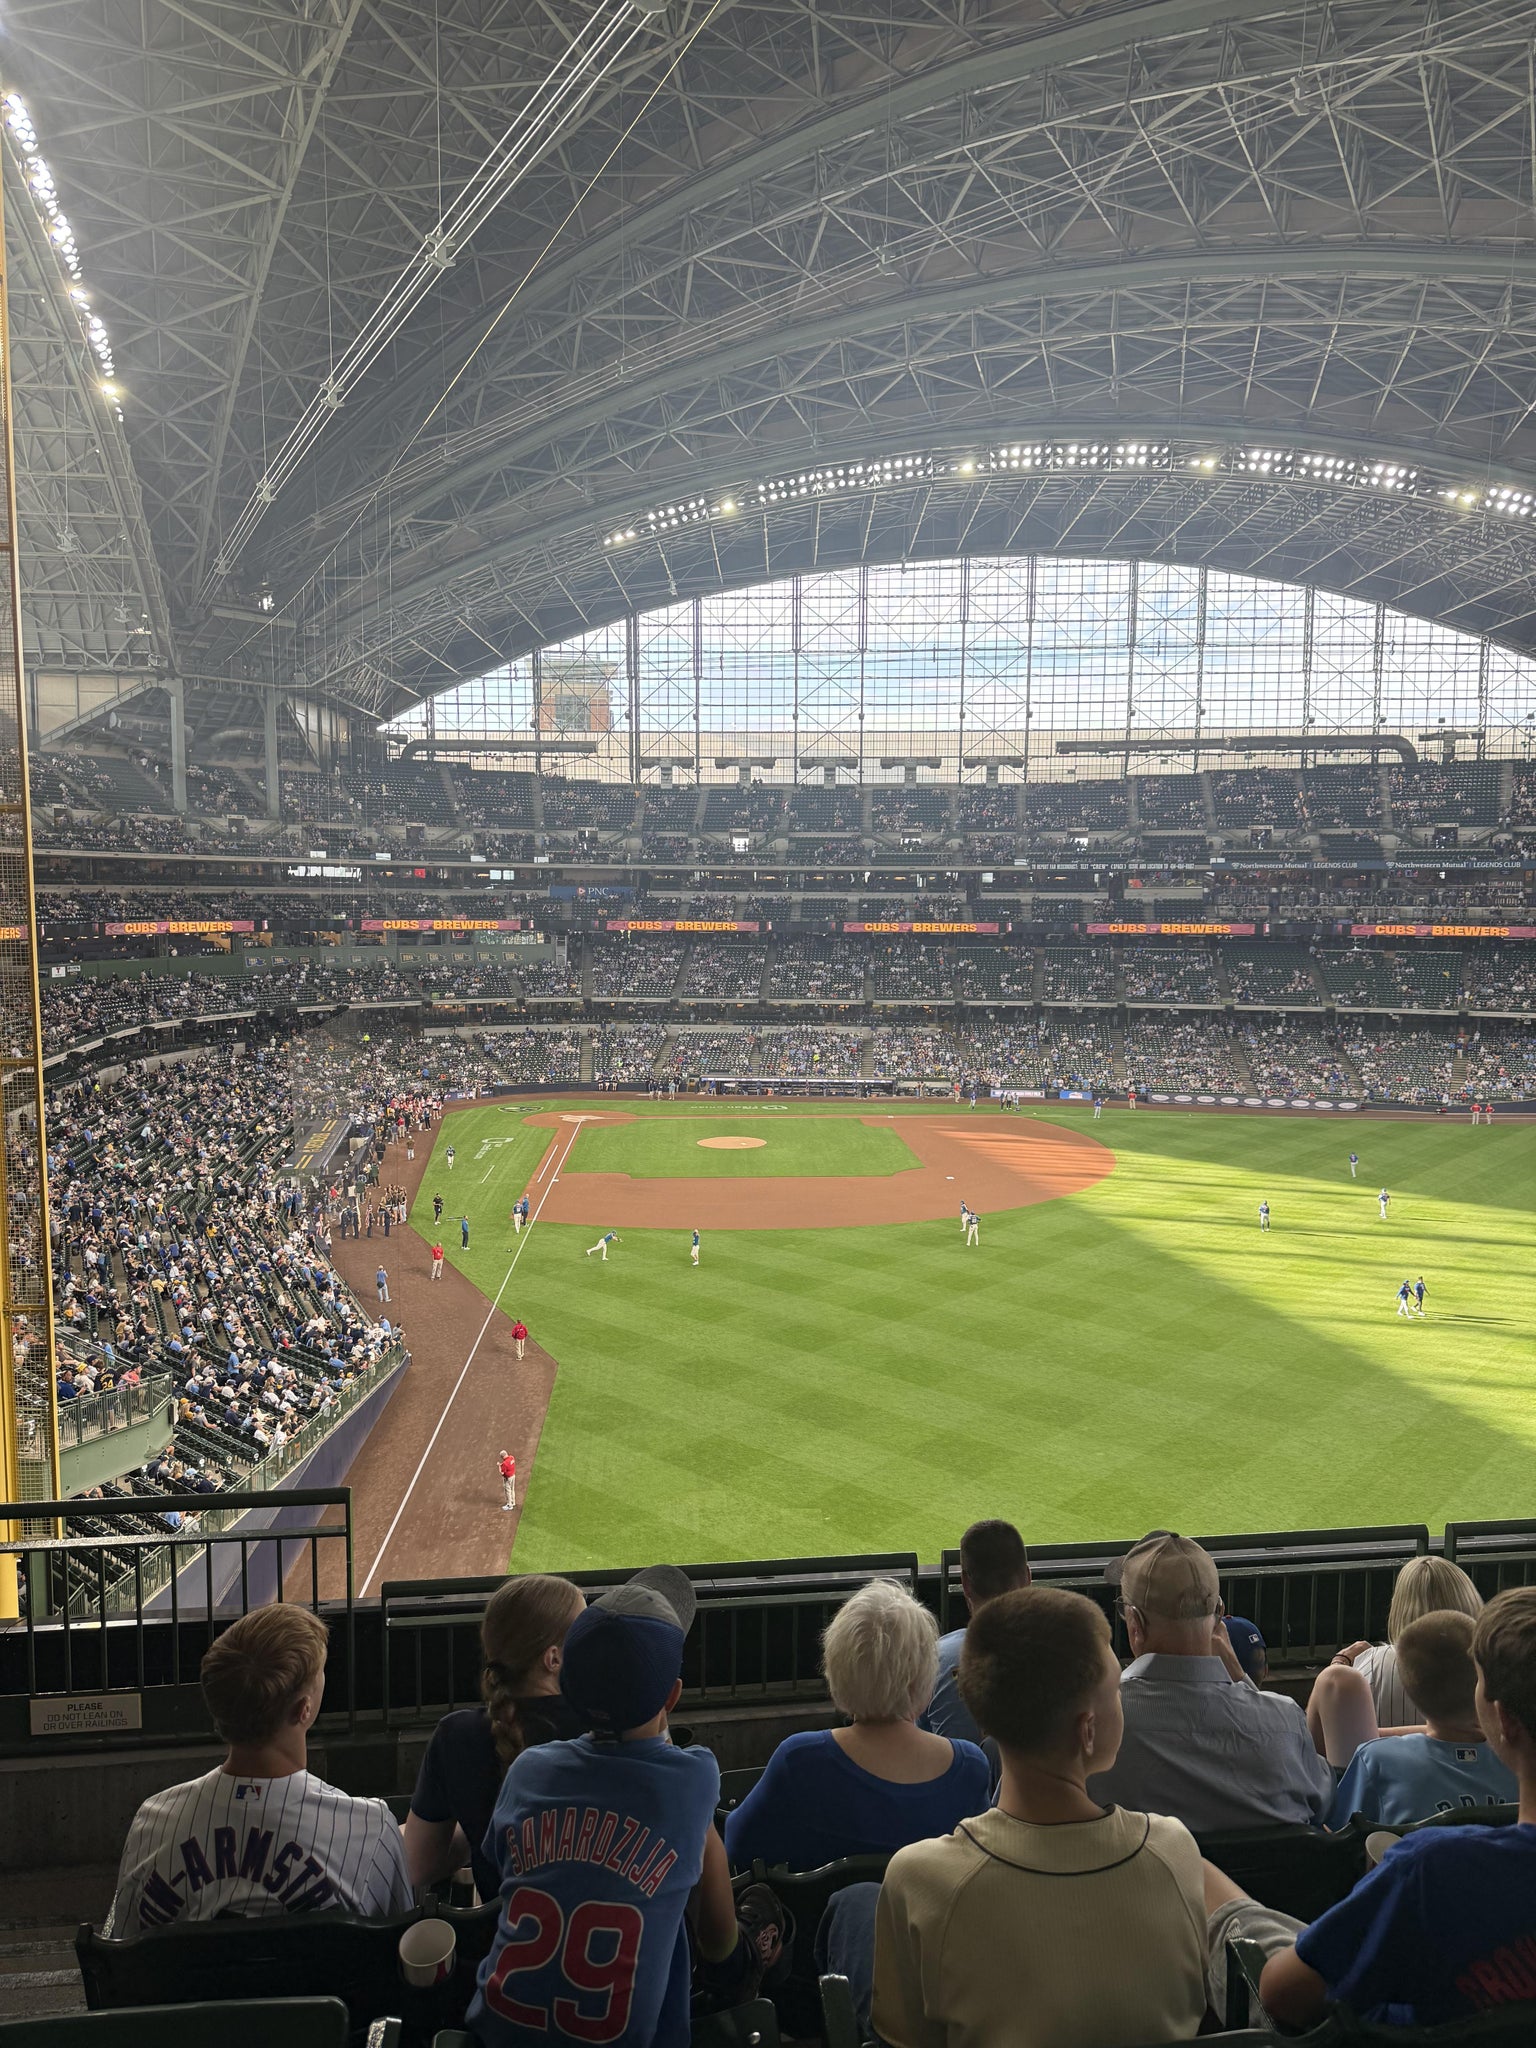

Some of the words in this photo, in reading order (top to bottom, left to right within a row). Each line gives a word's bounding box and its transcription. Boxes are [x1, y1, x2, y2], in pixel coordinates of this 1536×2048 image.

[588, 887, 608, 896] PNC
[124, 922, 158, 934] CUBS
[169, 921, 233, 932] BREWERS
[382, 920, 419, 930] CUBS
[432, 920, 499, 930] BREWERS
[628, 921, 662, 931] CUBS
[675, 921, 738, 931] BREWERS
[864, 922, 899, 932] CUBS
[912, 922, 977, 932] BREWERS
[1109, 923, 1147, 933] CUBS
[1160, 923, 1232, 934] BREWERS
[1375, 925, 1417, 935] CUBS
[1431, 925, 1510, 936] BREWERS
[67, 1702, 103, 1711] PLEASE
[47, 1714, 60, 1723] DO
[62, 1713, 81, 1721] NOT
[83, 1711, 108, 1720] LEAN
[109, 1710, 123, 1719] ON
[43, 1722, 57, 1731] OR
[58, 1721, 83, 1730] OVER
[85, 1718, 128, 1728] RAILINGS
[506, 1806, 679, 1898] SAMARDZIJA
[485, 1886, 644, 2044] 29
